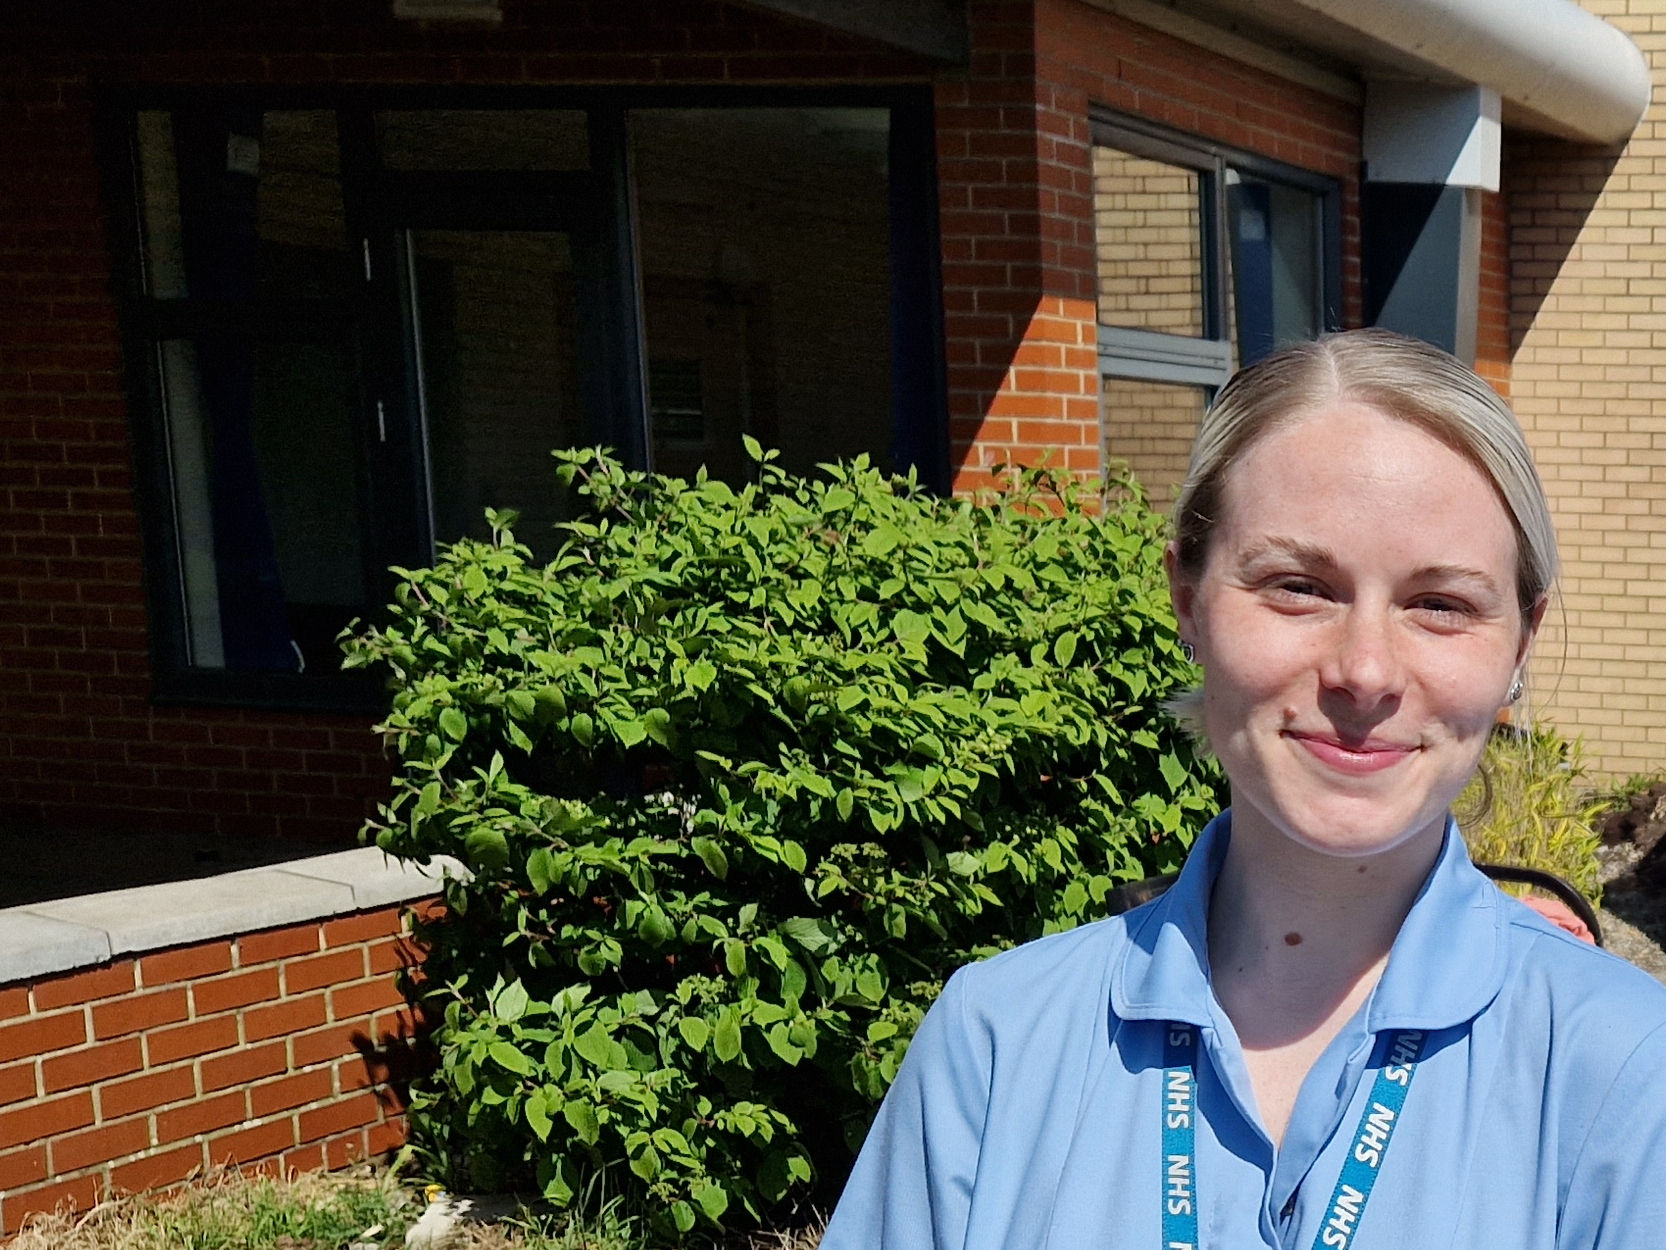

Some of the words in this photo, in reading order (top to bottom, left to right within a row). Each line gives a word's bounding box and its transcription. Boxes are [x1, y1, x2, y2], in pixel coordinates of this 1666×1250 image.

[1167, 1071, 1191, 1130] NHS
[1355, 1102, 1395, 1168] NHS
[1167, 1155, 1191, 1216] NHS
[1323, 1184, 1364, 1250] NHS
